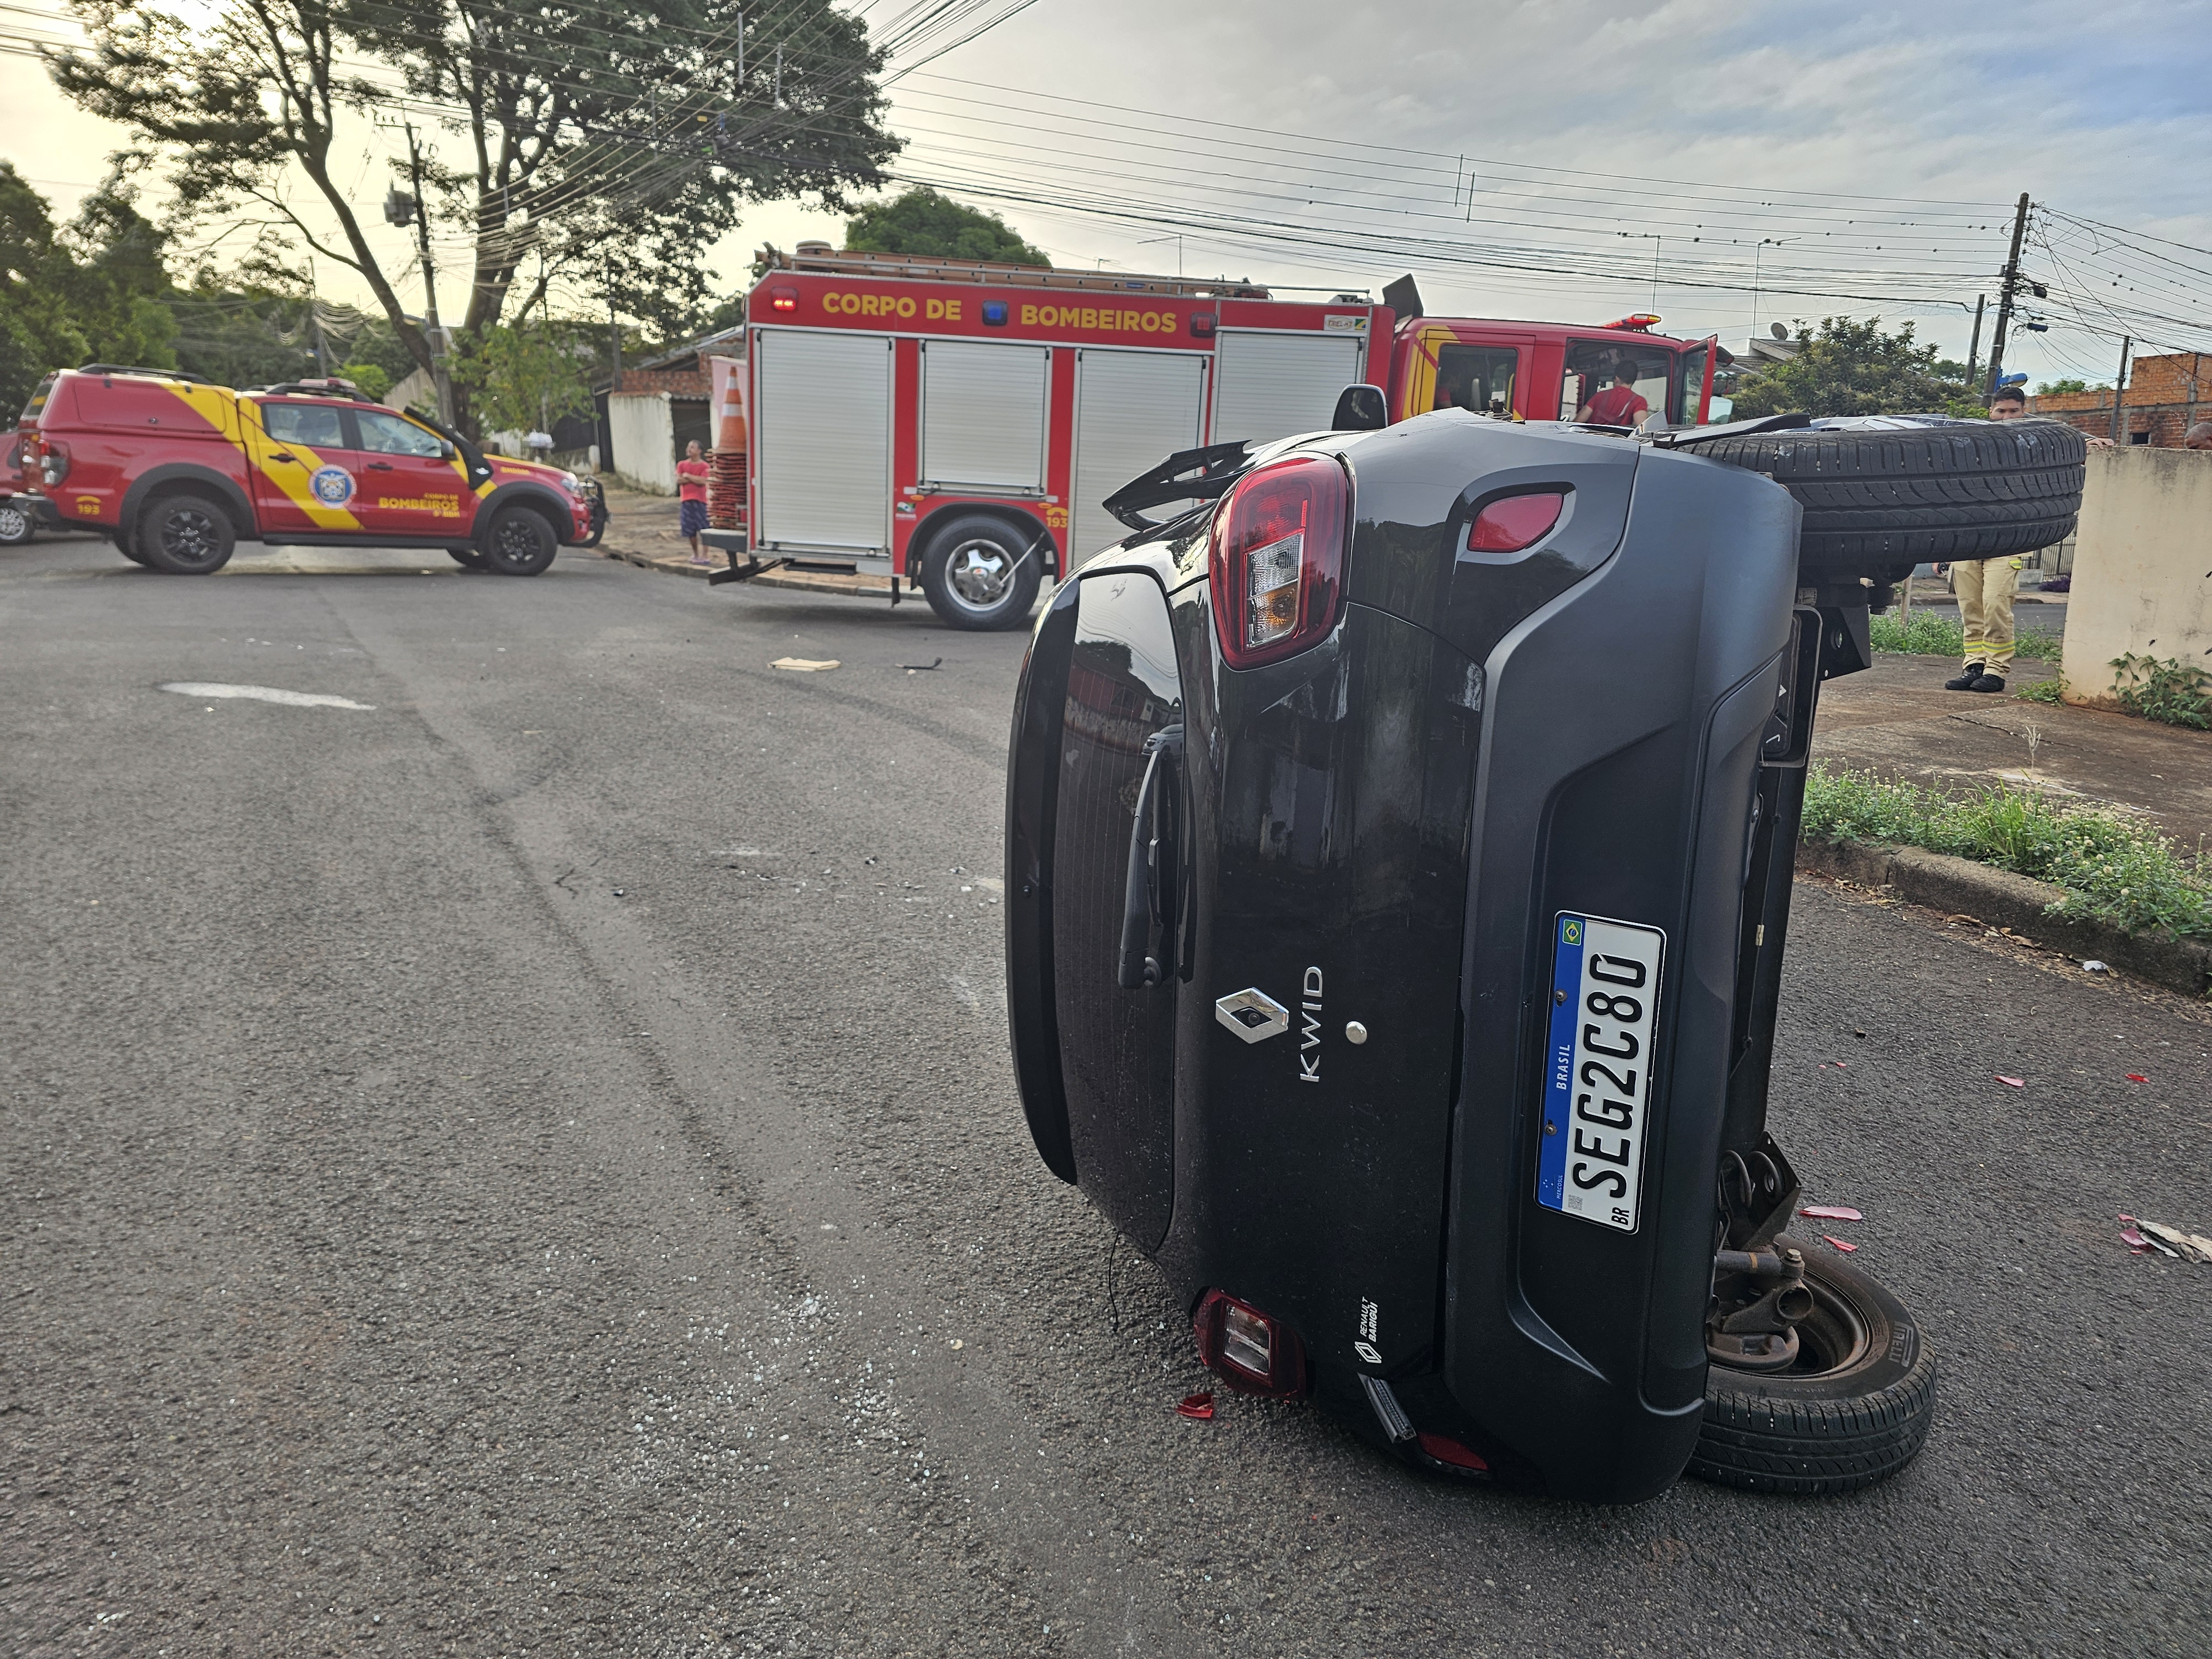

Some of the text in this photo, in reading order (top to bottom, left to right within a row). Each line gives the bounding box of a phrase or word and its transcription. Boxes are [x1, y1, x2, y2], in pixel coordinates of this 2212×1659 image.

[822, 292, 1177, 333] CORPO DE BOMBEIROS
[77, 504, 100, 515] 193
[379, 497, 460, 511] BOMBEIROS
[1046, 517, 1067, 528] 193
[1300, 967, 1323, 1082] KWID
[1556, 1044, 1571, 1091] BRASIL
[1572, 952, 1647, 1198] SEG2C80
[1611, 1206, 1630, 1226] BR
[1360, 1296, 1370, 1337] RENAULT
[1888, 1321, 1913, 1367] PIRELLI
